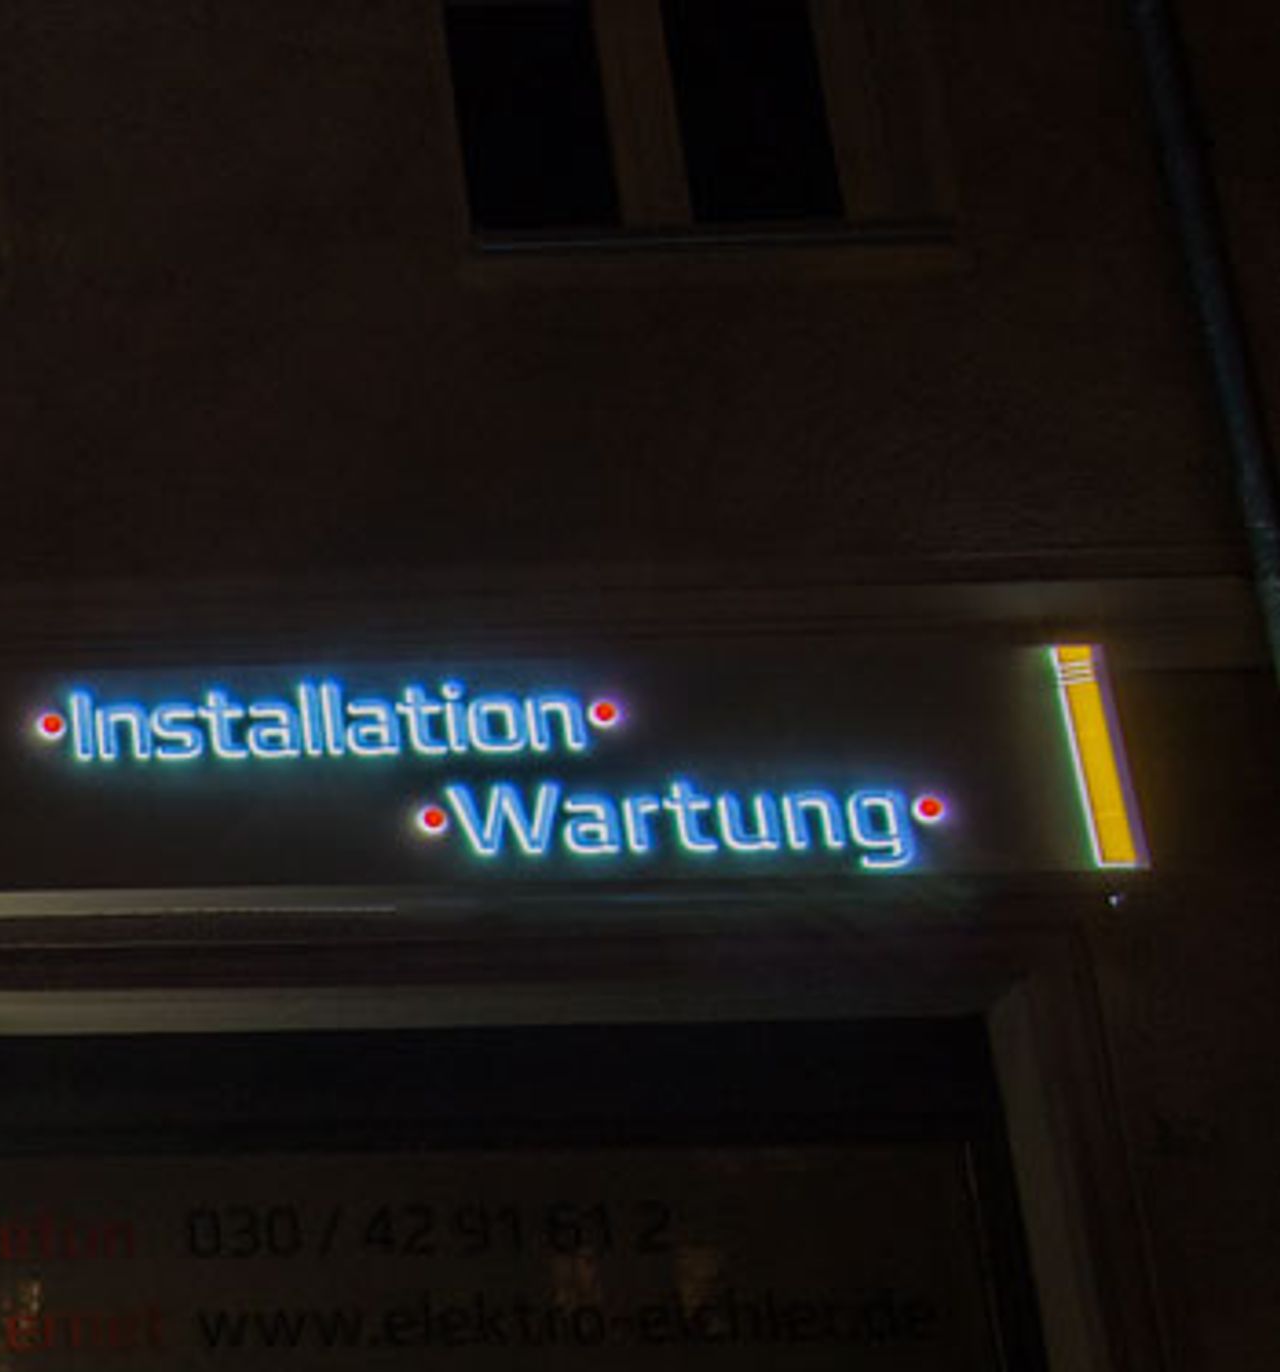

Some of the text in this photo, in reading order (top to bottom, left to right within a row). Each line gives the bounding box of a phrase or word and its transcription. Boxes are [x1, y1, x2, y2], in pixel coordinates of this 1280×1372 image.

[66, 678, 590, 762] Installation
[444, 780, 916, 870] Wartung
[186, 1204, 302, 1260] 030
[364, 1202, 434, 1256] 42
[456, 1202, 522, 1254] 91
[546, 1202, 614, 1254] 61
[638, 1200, 674, 1252] 2
